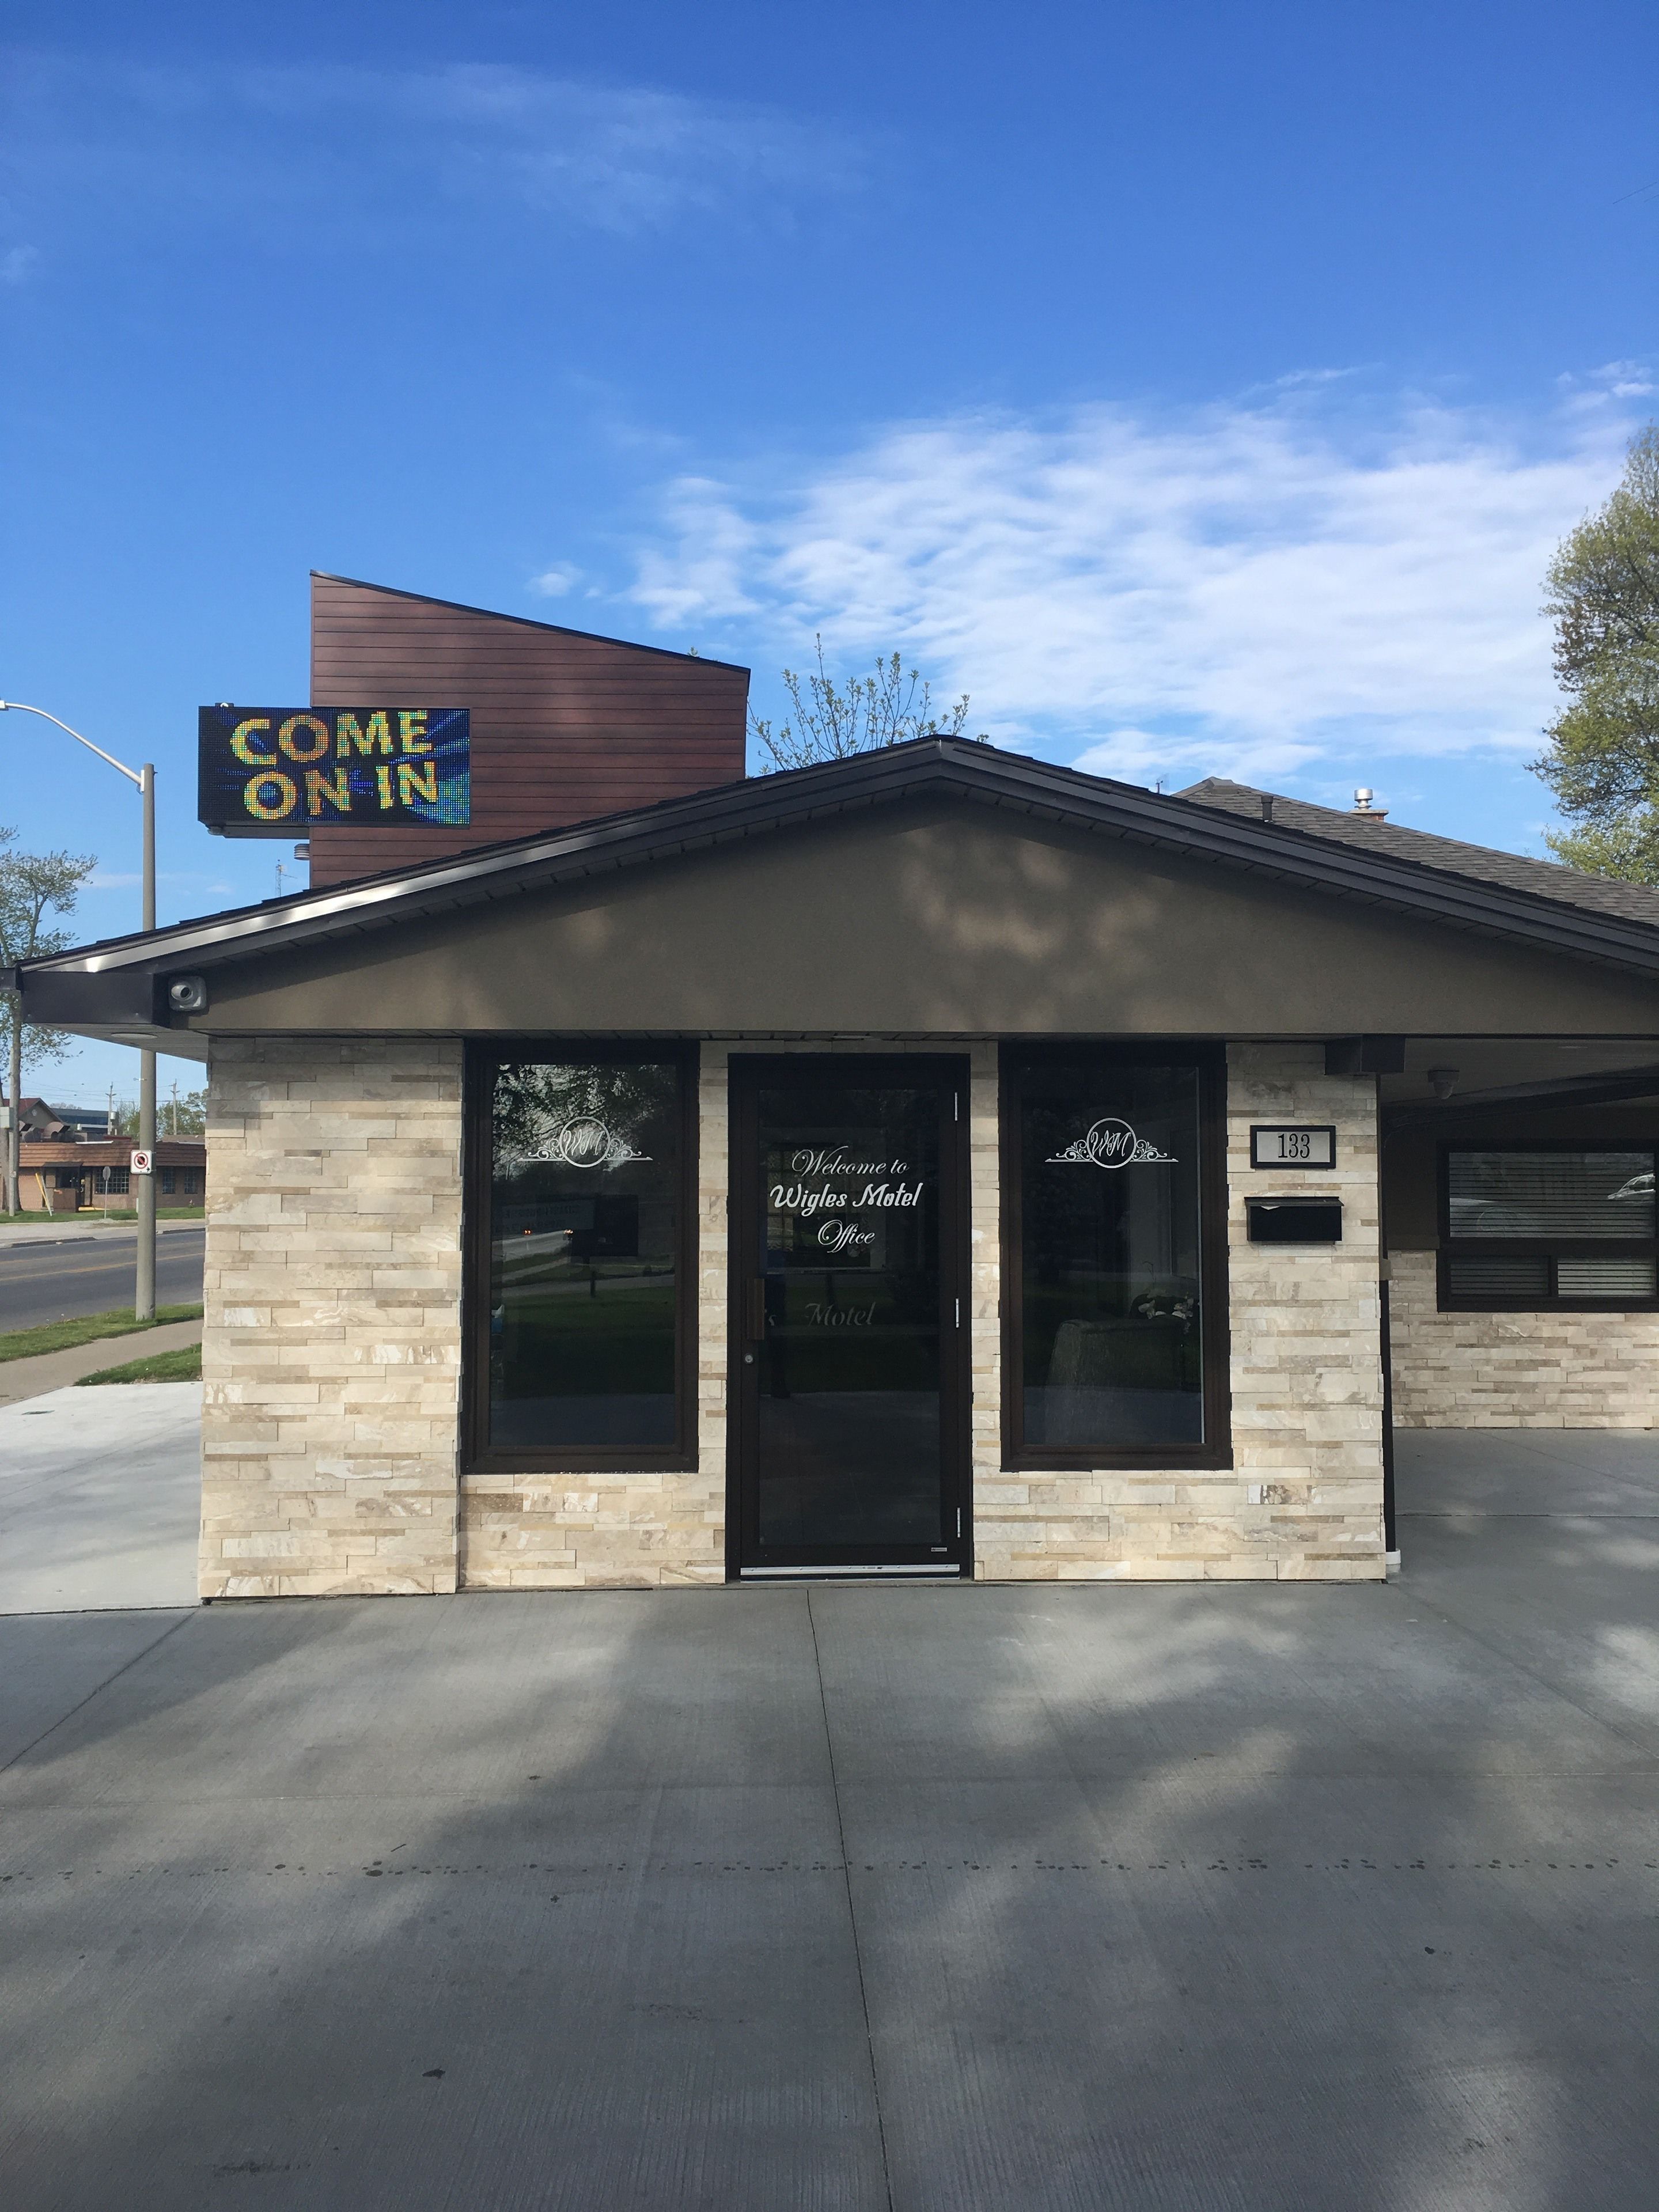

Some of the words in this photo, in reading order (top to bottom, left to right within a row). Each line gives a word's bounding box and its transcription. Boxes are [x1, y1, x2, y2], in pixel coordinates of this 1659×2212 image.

[230, 710, 433, 765] COME
[243, 767, 353, 820] ON
[376, 761, 438, 809] IN
[791, 1146, 886, 1176] Welcome
[890, 1159, 910, 1174] to
[1277, 1133, 1310, 1158] 133
[770, 1183, 848, 1217] Wigles
[852, 1183, 923, 1207] Motel
[817, 1219, 876, 1253] Office
[804, 1301, 876, 1327] Motel
